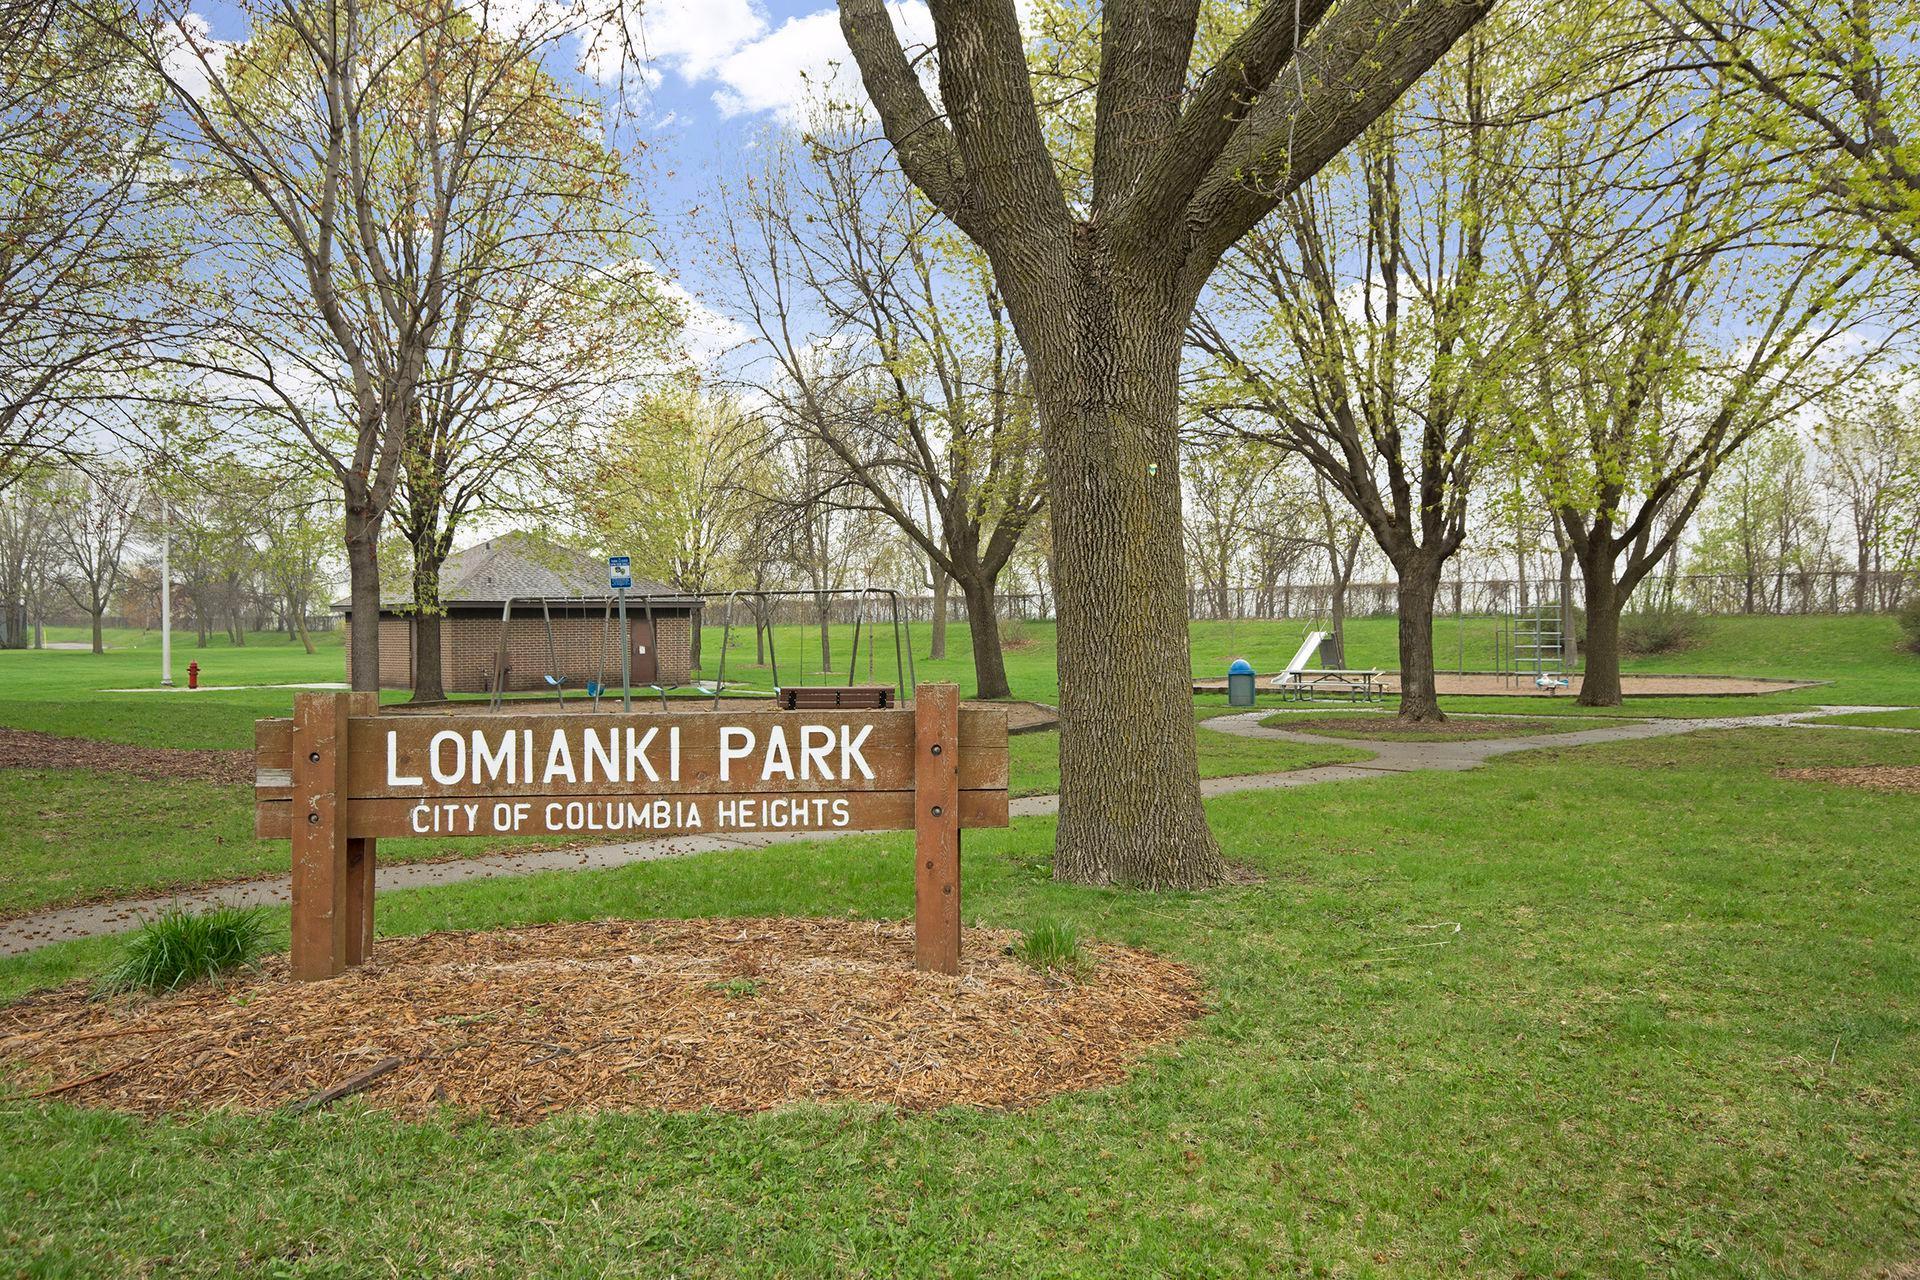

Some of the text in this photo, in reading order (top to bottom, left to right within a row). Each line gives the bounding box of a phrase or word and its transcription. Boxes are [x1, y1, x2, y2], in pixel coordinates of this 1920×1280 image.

[387, 724, 875, 786] LOMIANKI PARK
[411, 799, 850, 833] CITY OF COLUMBIA HEIGHTS
